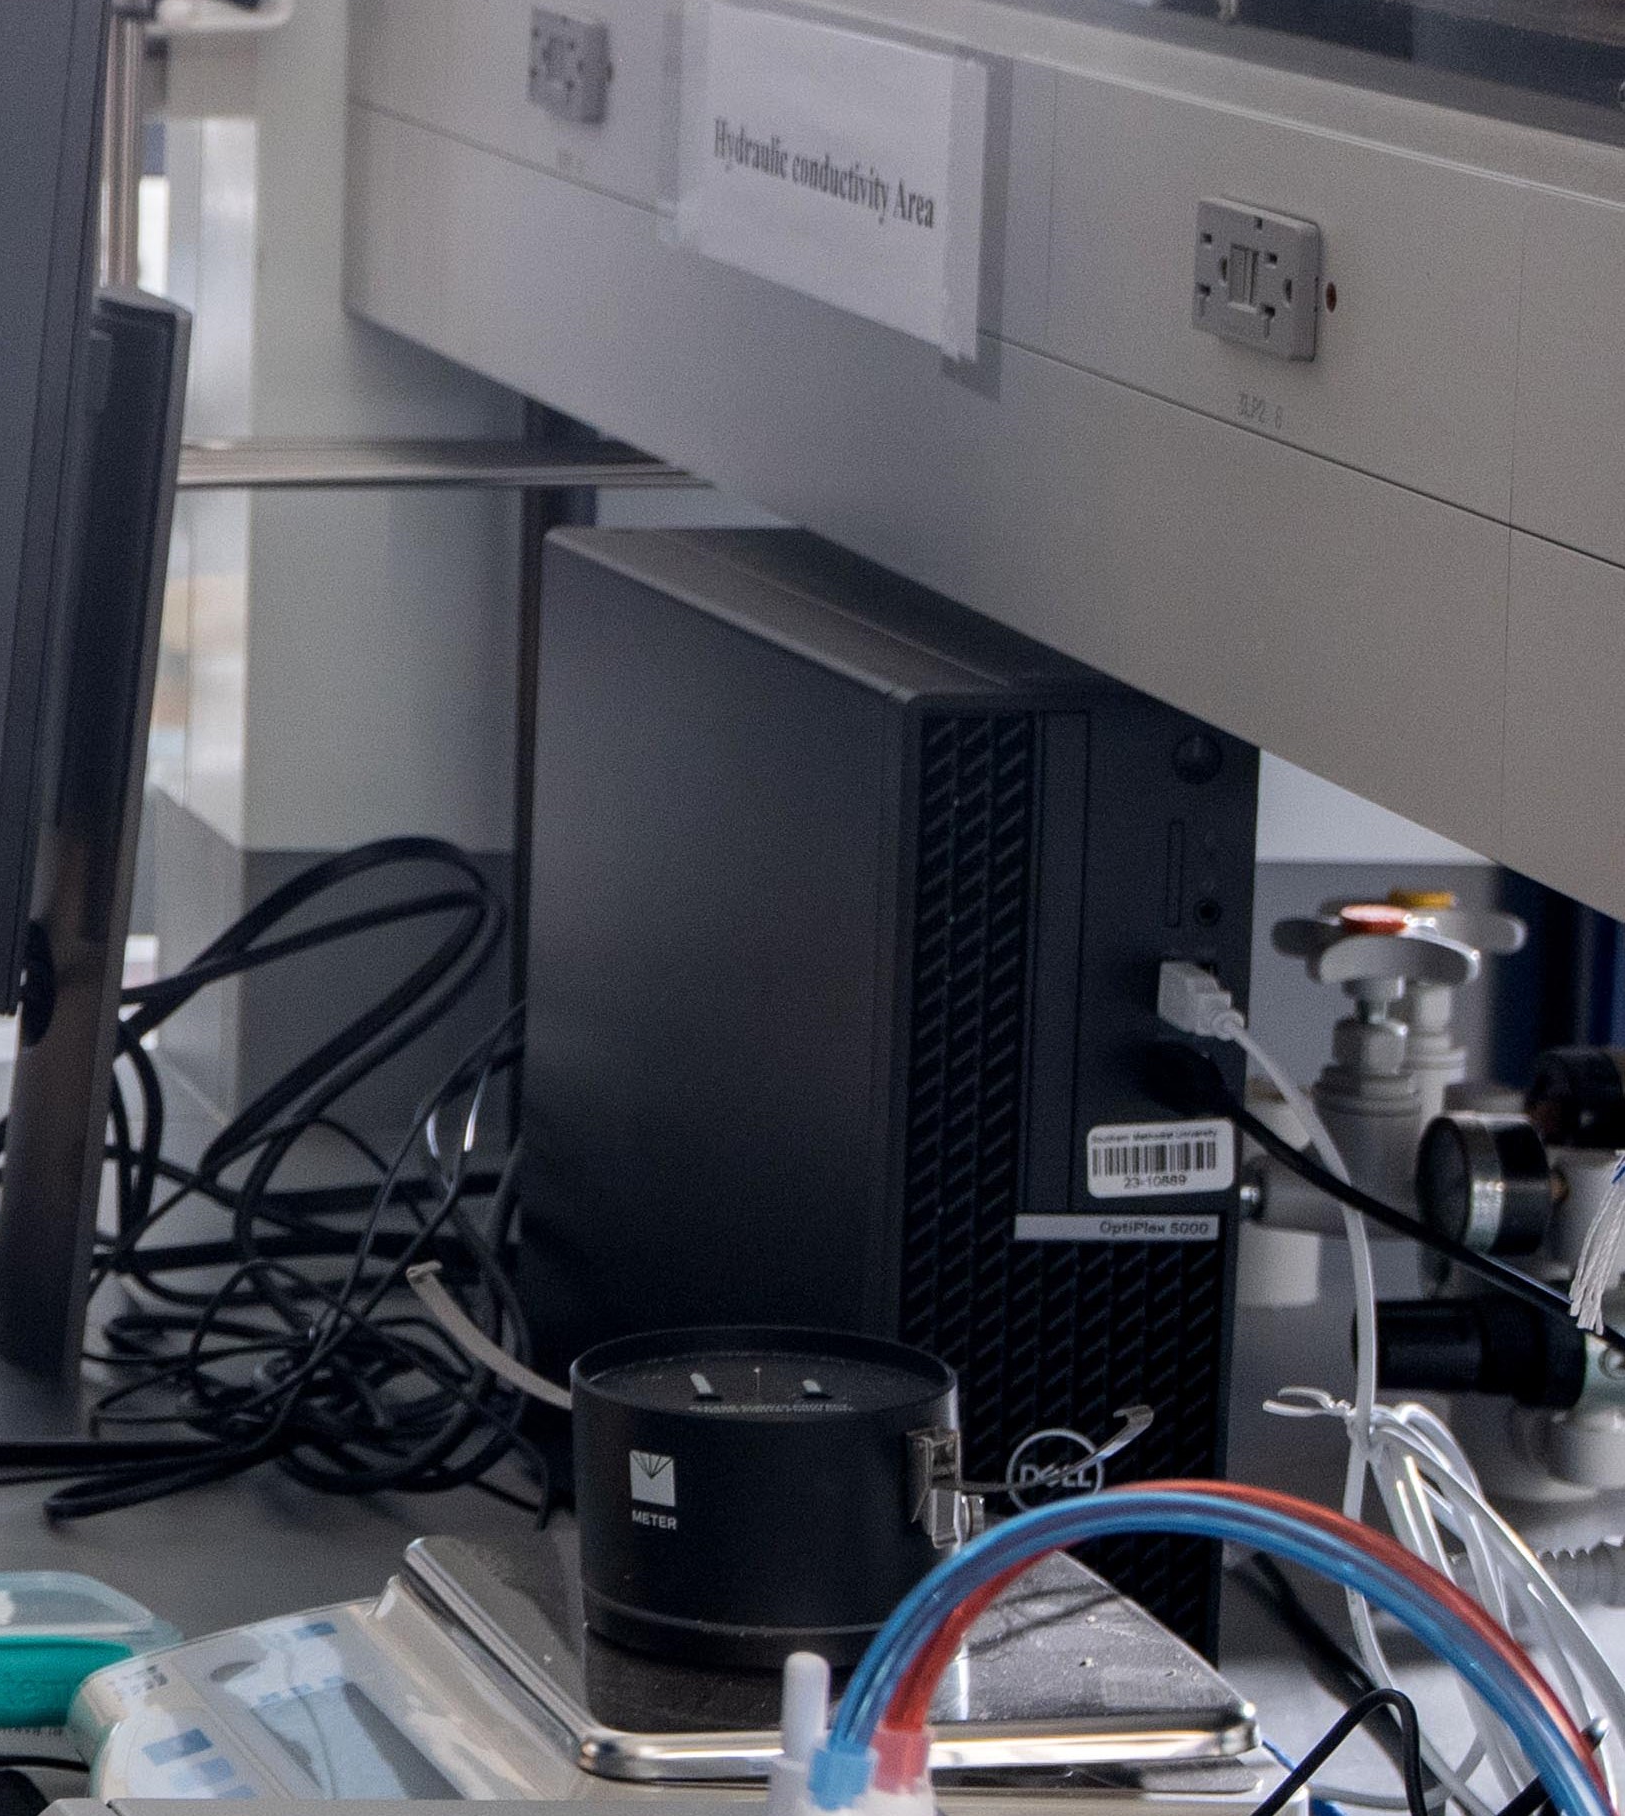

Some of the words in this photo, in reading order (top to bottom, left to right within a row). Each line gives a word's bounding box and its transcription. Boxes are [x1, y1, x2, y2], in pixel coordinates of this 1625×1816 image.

[714, 115, 788, 179] Hydraulic
[793, 153, 890, 225] conductivity
[894, 178, 935, 229] Area
[1100, 1220, 1166, 1235] OptiPlex
[1170, 1221, 1209, 1235] 5000
[1020, 1464, 1092, 1488] DELL
[632, 1509, 677, 1530] METER
